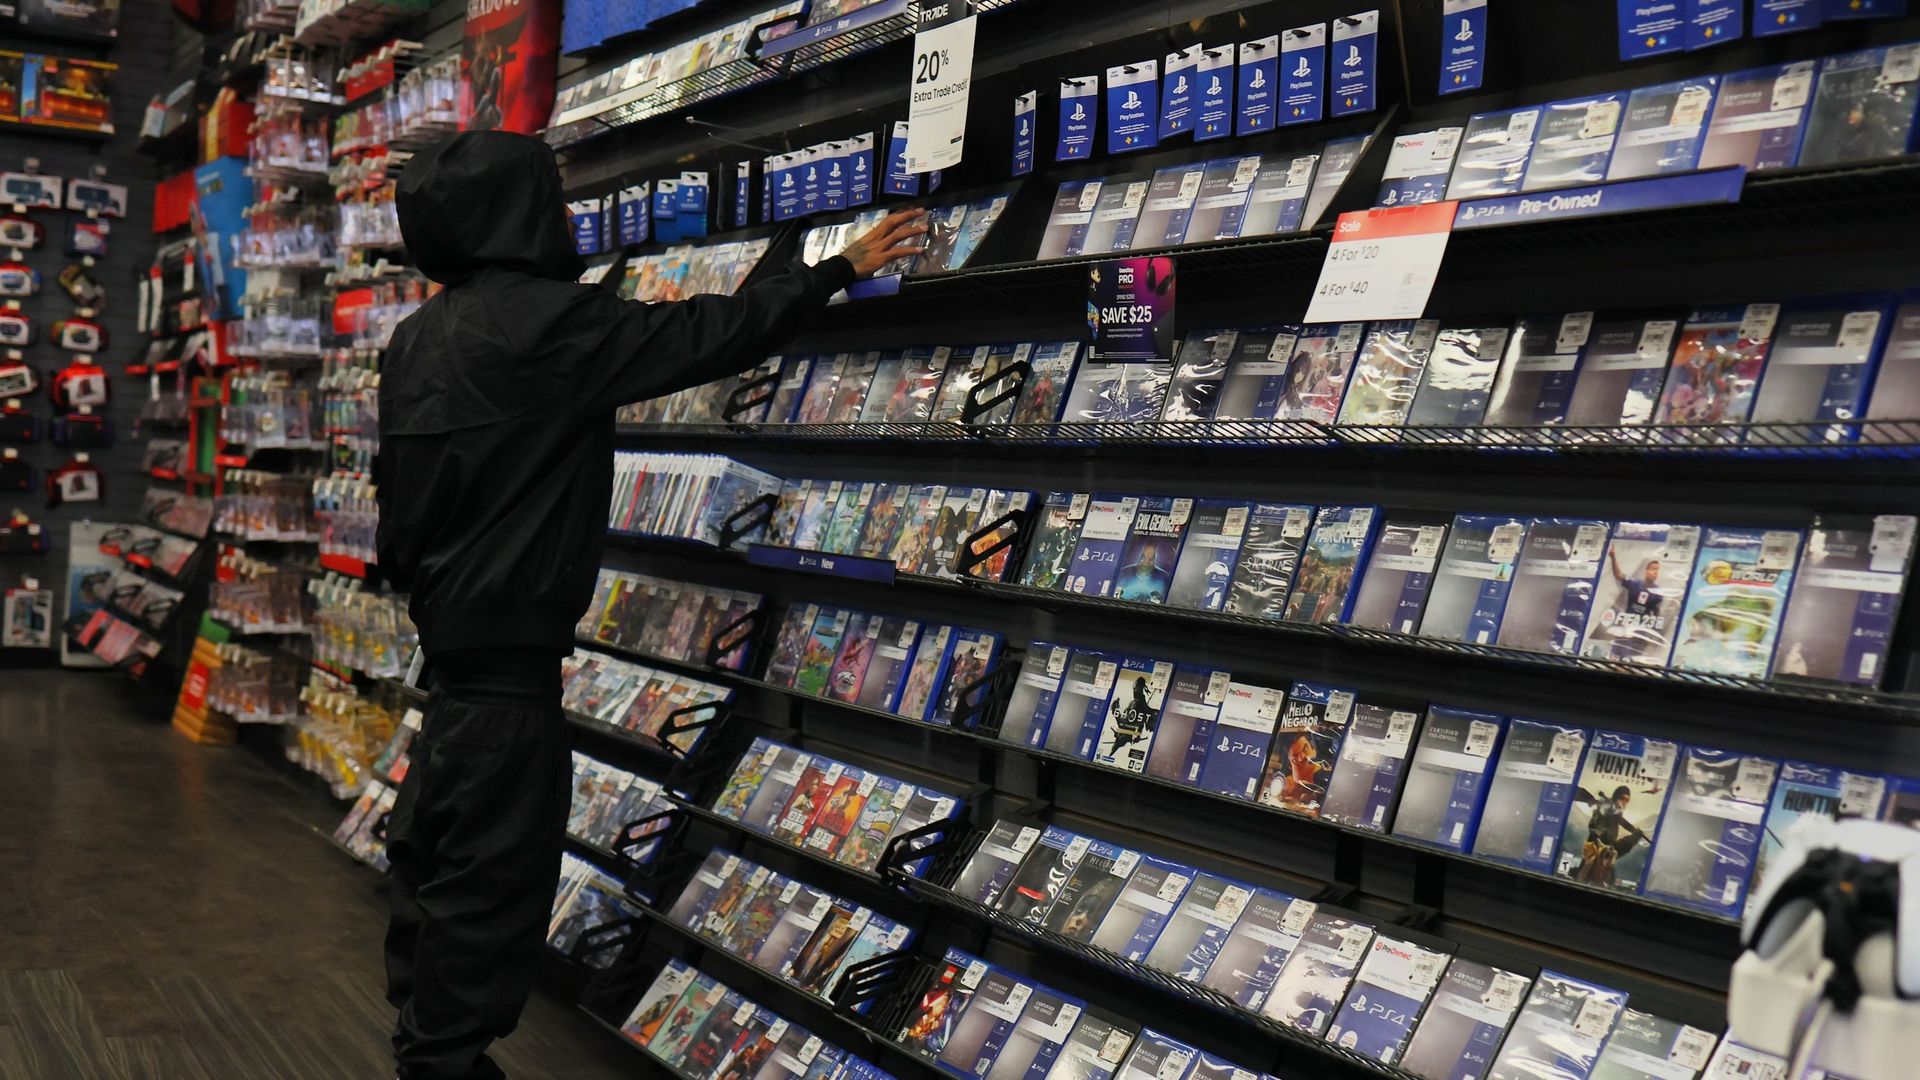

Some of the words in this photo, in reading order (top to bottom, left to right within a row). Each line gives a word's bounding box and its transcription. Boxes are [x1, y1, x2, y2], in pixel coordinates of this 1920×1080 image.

[1636, 4, 1675, 16] PlayStation
[916, 48, 949, 84] 20%
[1341, 70, 1364, 79] PlayStation
[914, 91, 931, 102] Extra
[934, 85, 951, 98] Trade
[952, 79, 968, 94] Credit
[1290, 81, 1312, 90] PlayStation
[1120, 112, 1144, 121] PlayStation
[1396, 139, 1424, 149] PreOwned
[1476, 206, 1505, 217] PS4
[1518, 190, 1603, 215] Pre-Owned
[1340, 221, 1361, 232] Sale
[1331, 249, 1338, 260] 4
[1340, 249, 1359, 262] For
[1361, 246, 1379, 259] $20
[1118, 274, 1134, 284] PRO
[1320, 284, 1327, 296] 4
[1329, 284, 1348, 296] For
[1350, 281, 1368, 294] $40
[1102, 307, 1127, 324] SAVE
[1129, 305, 1152, 324] $25
[1147, 500, 1162, 508] PS4
[1135, 514, 1148, 530] EVIL
[1091, 551, 1115, 562] PS4
[821, 558, 834, 569] New
[1615, 612, 1641, 627] FIFA
[1641, 614, 1655, 629] 23
[1129, 660, 1145, 669] PS4
[1228, 688, 1252, 698] PreOwned
[1114, 708, 1152, 723] GHOST
[1289, 702, 1313, 717] HELLO
[1281, 716, 1318, 728] NEIGHBOR
[1429, 726, 1459, 737] CERTIFIED
[1232, 742, 1261, 758] PS4
[1594, 753, 1653, 782] HUNTI
[1051, 833, 1066, 841] PS4
[1098, 846, 1113, 855] PS4
[1255, 905, 1280, 917] CERTIFIED
[1382, 944, 1413, 960] PreOwned
[954, 955, 966, 964] PS4
[1454, 972, 1485, 986] CERTIFIED
[1369, 1003, 1405, 1025] PS4
